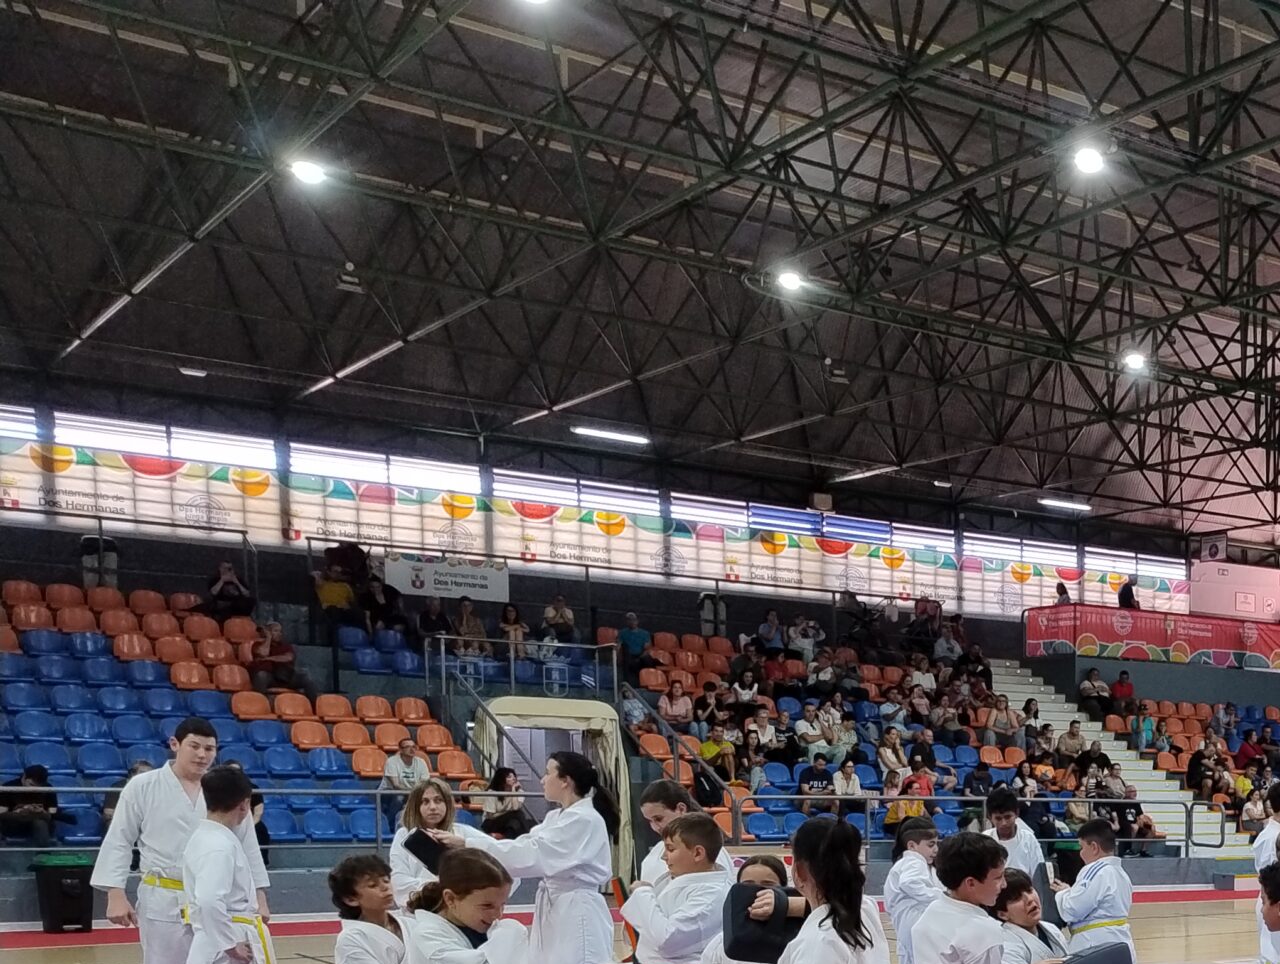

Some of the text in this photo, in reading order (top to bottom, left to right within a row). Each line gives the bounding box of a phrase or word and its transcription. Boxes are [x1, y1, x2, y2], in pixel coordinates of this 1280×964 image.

[38, 485, 112, 502] Ayuntamiento
[38, 497, 126, 514] Dos Hermanas
[316, 527, 389, 541] Dos Hermanas
[549, 550, 612, 565] Dos Hermanas
[433, 577, 449, 586] Dos
[450, 579, 489, 590] Hermanas
